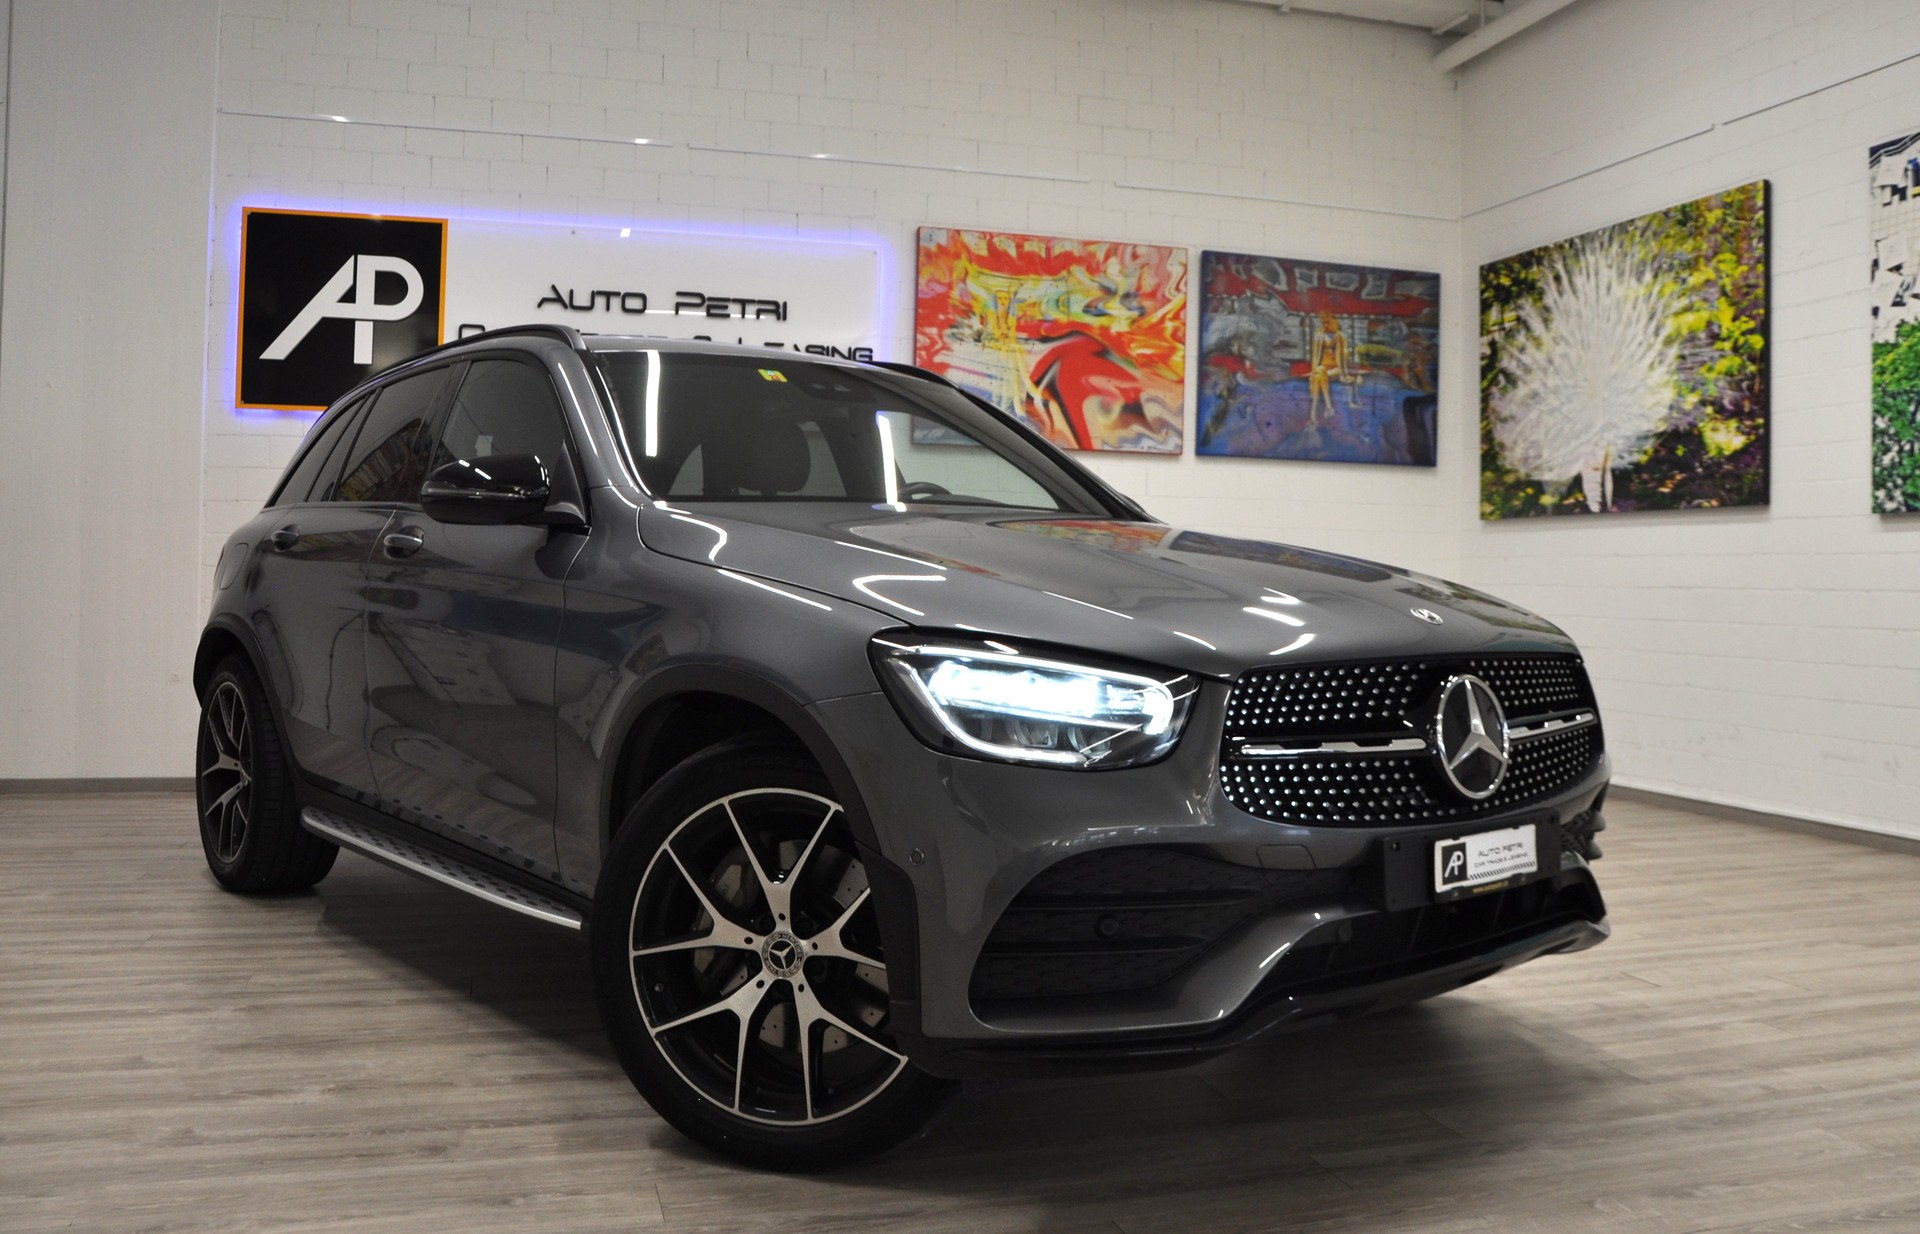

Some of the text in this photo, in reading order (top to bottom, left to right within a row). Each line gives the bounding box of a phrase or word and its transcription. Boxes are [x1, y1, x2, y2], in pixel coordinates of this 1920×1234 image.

[259, 254, 424, 365] AP
[537, 284, 788, 322] AUTO PETRI
[1444, 851, 1464, 878] AP
[1478, 847, 1500, 857] AUTO
